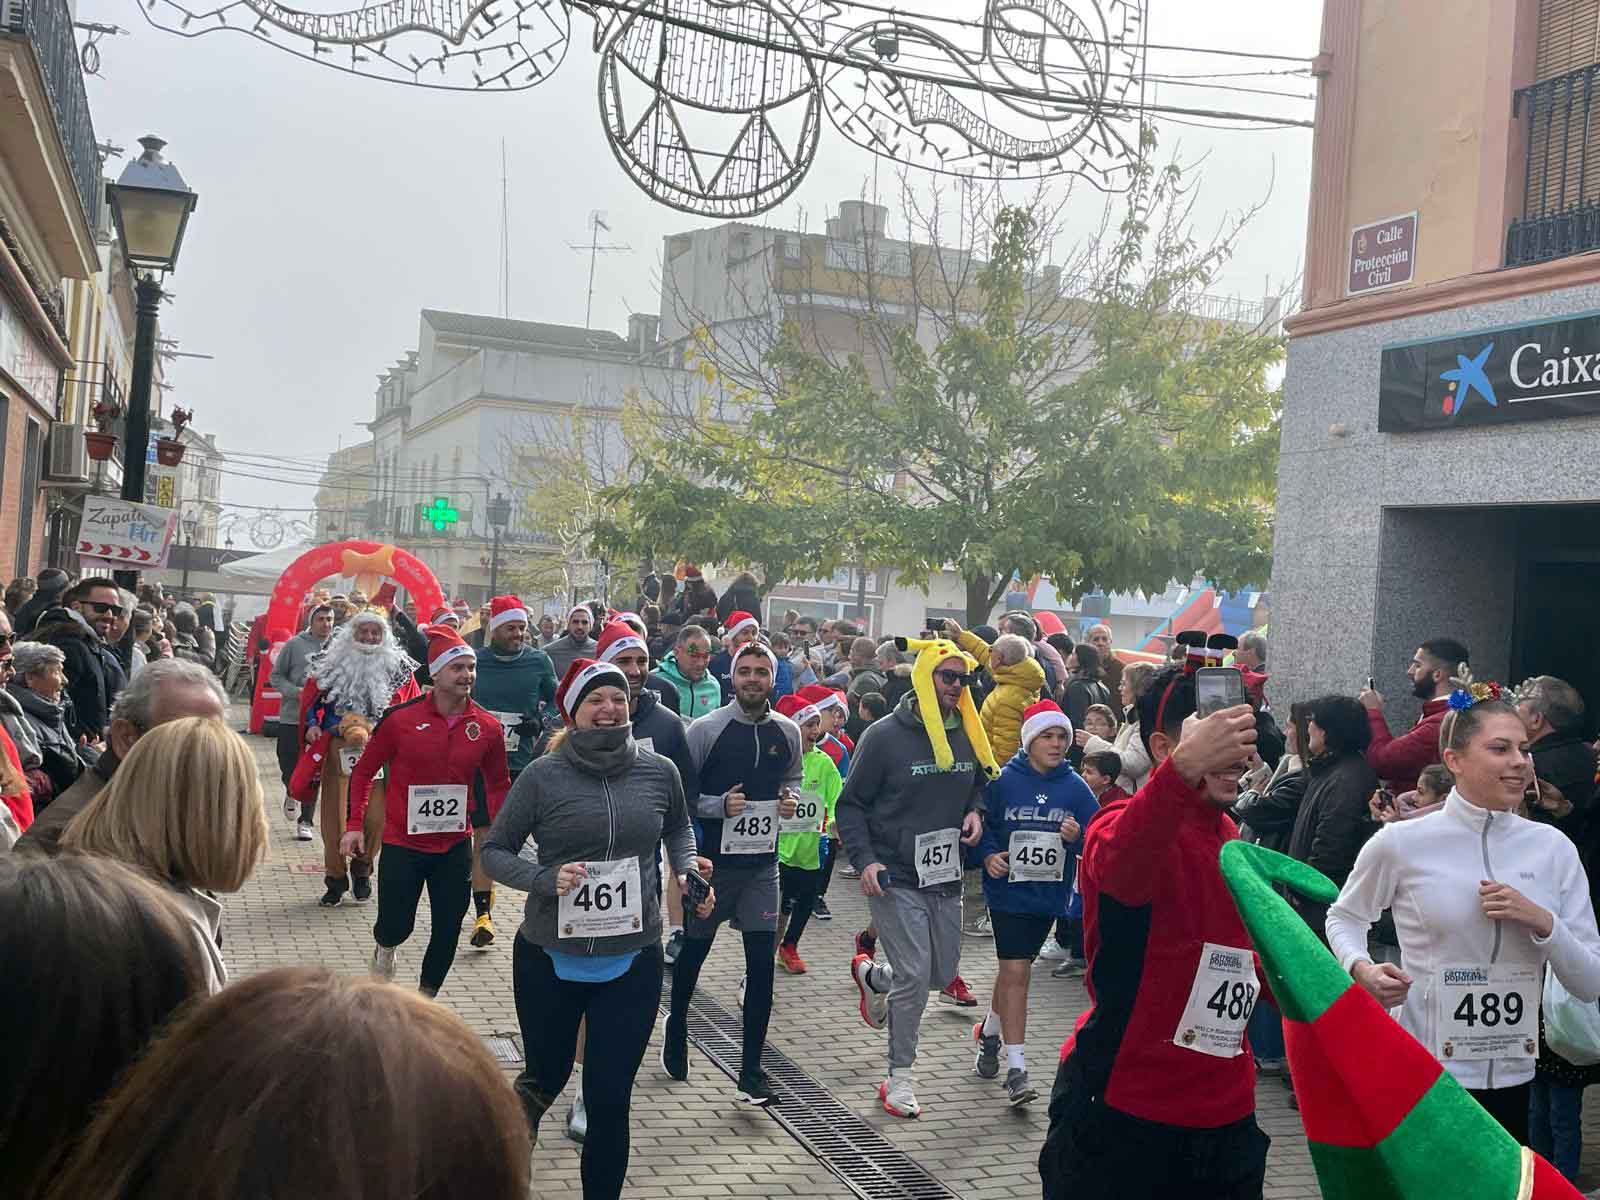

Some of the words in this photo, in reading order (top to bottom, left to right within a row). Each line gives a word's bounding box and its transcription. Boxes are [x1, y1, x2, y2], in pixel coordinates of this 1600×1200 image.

[1376, 225, 1403, 245] Calle
[1354, 247, 1408, 274] Protección
[1367, 266, 1391, 286] Civil
[418, 798, 459, 817] 482
[796, 802, 817, 818] 60
[733, 815, 772, 836] 483
[921, 843, 953, 867] 457
[1015, 846, 1057, 866] 456
[573, 880, 627, 912] 461
[1207, 980, 1255, 1020] 488
[1453, 992, 1524, 1028] 489
